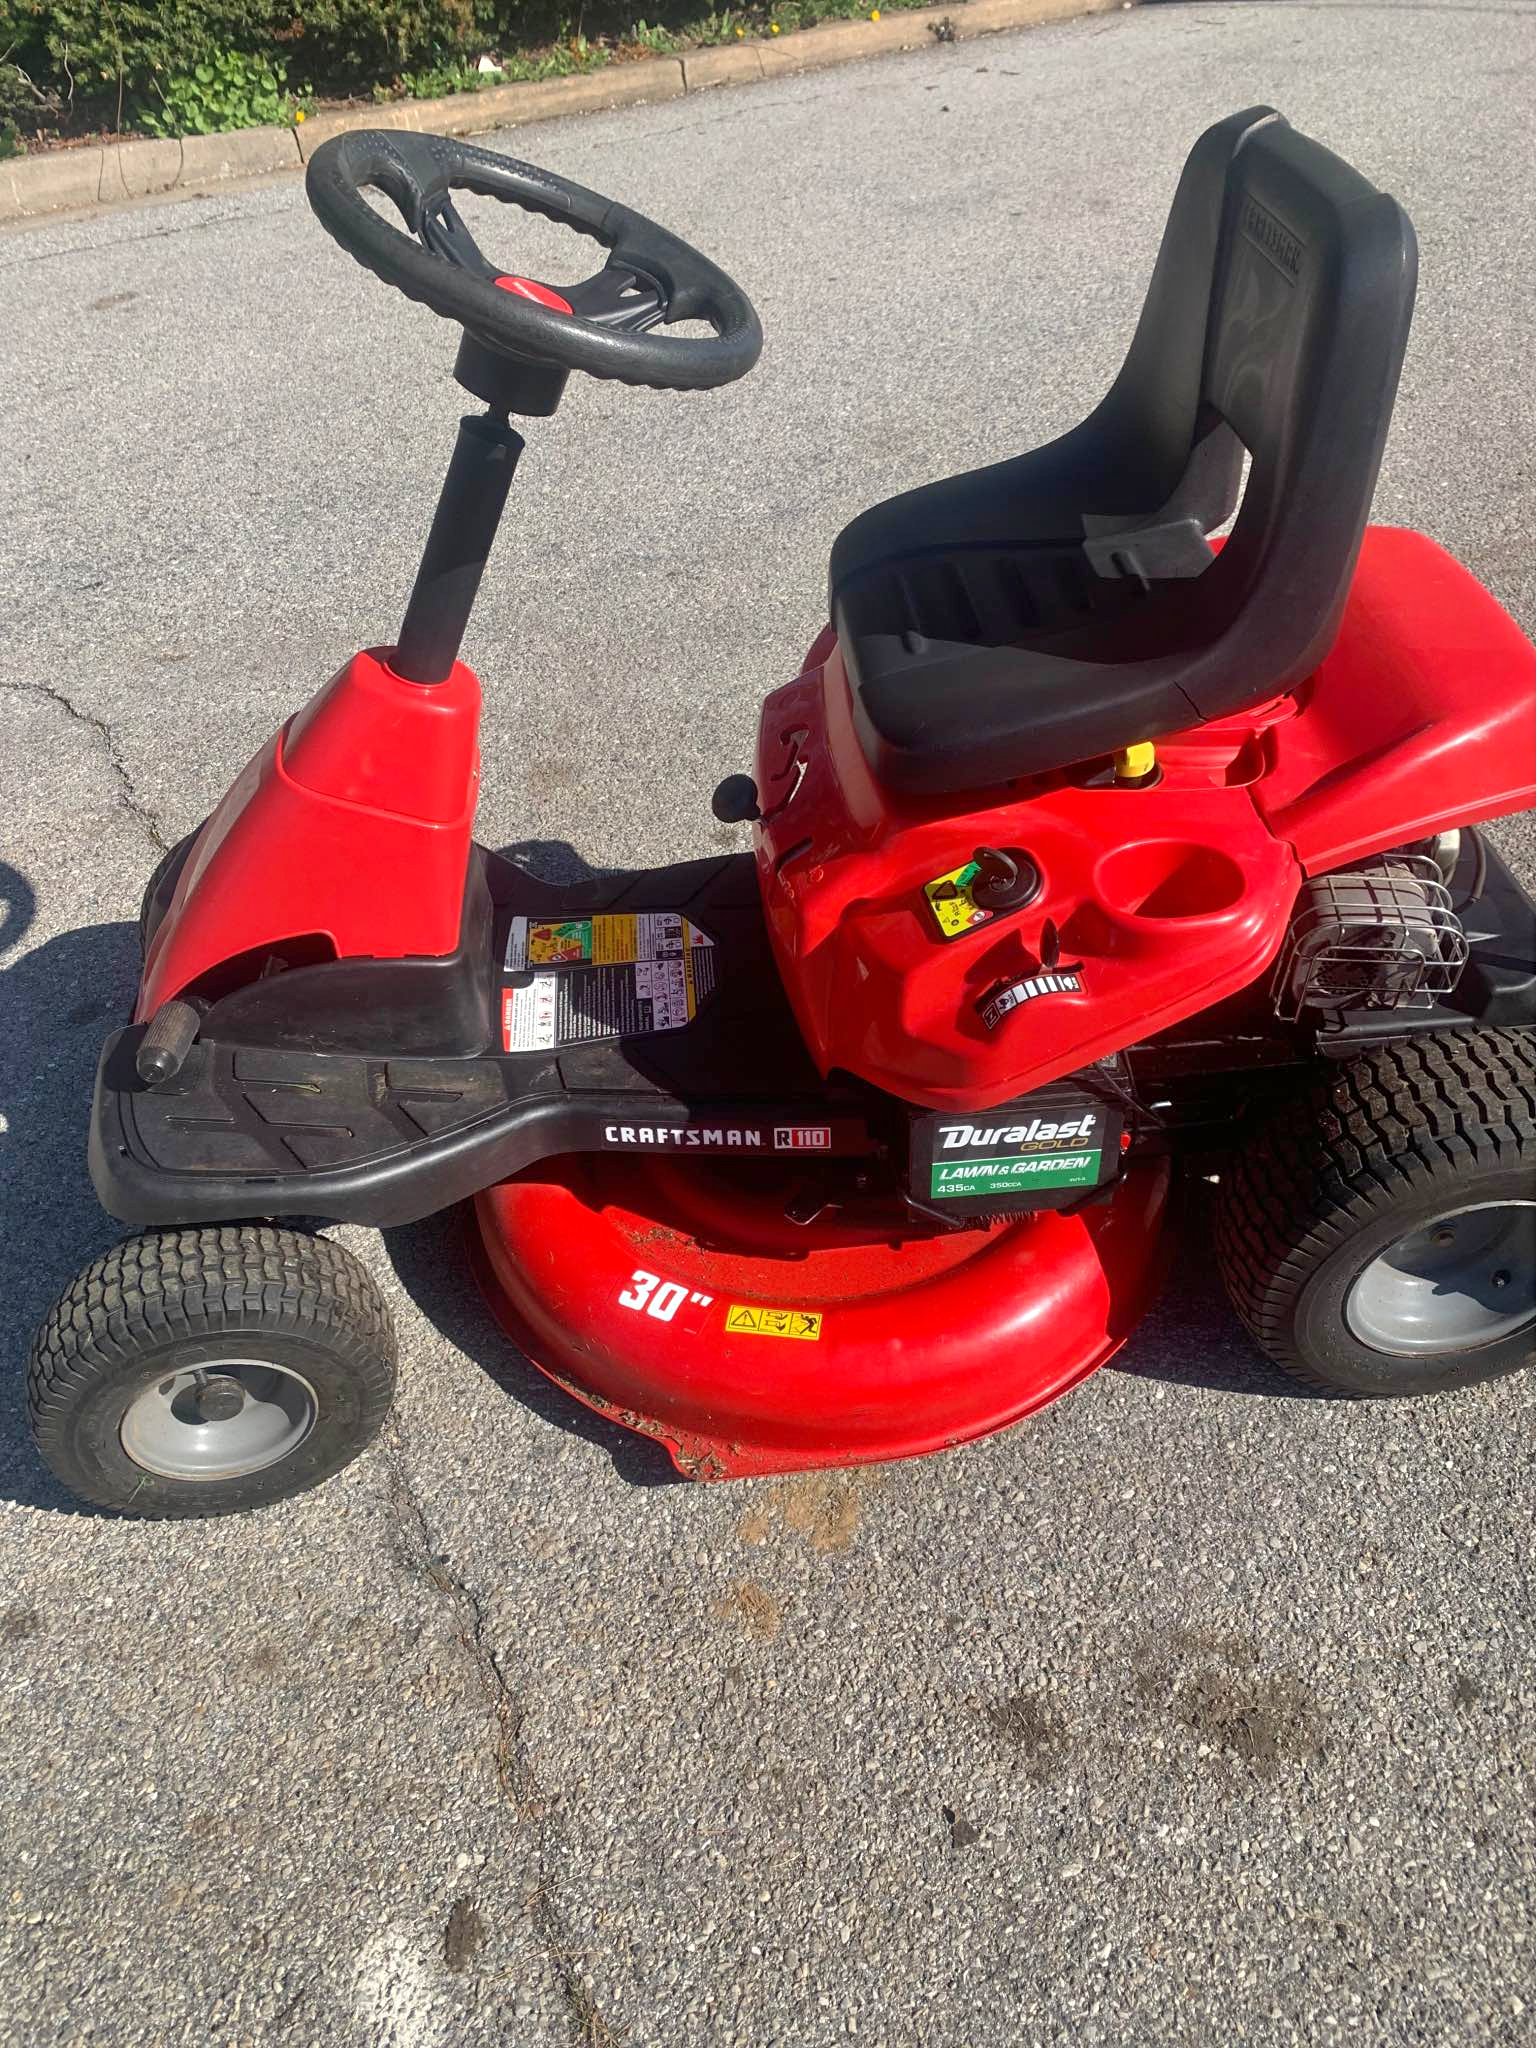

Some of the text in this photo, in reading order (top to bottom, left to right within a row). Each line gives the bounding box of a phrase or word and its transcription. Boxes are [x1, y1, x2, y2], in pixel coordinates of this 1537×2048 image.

[605, 1126, 761, 1147] CRAFTSMAN
[938, 1114, 1096, 1149] Duralast
[1020, 1138, 1089, 1152] GOLD
[939, 1163, 998, 1180] LAWN
[1010, 1156, 1091, 1174] GARDEN
